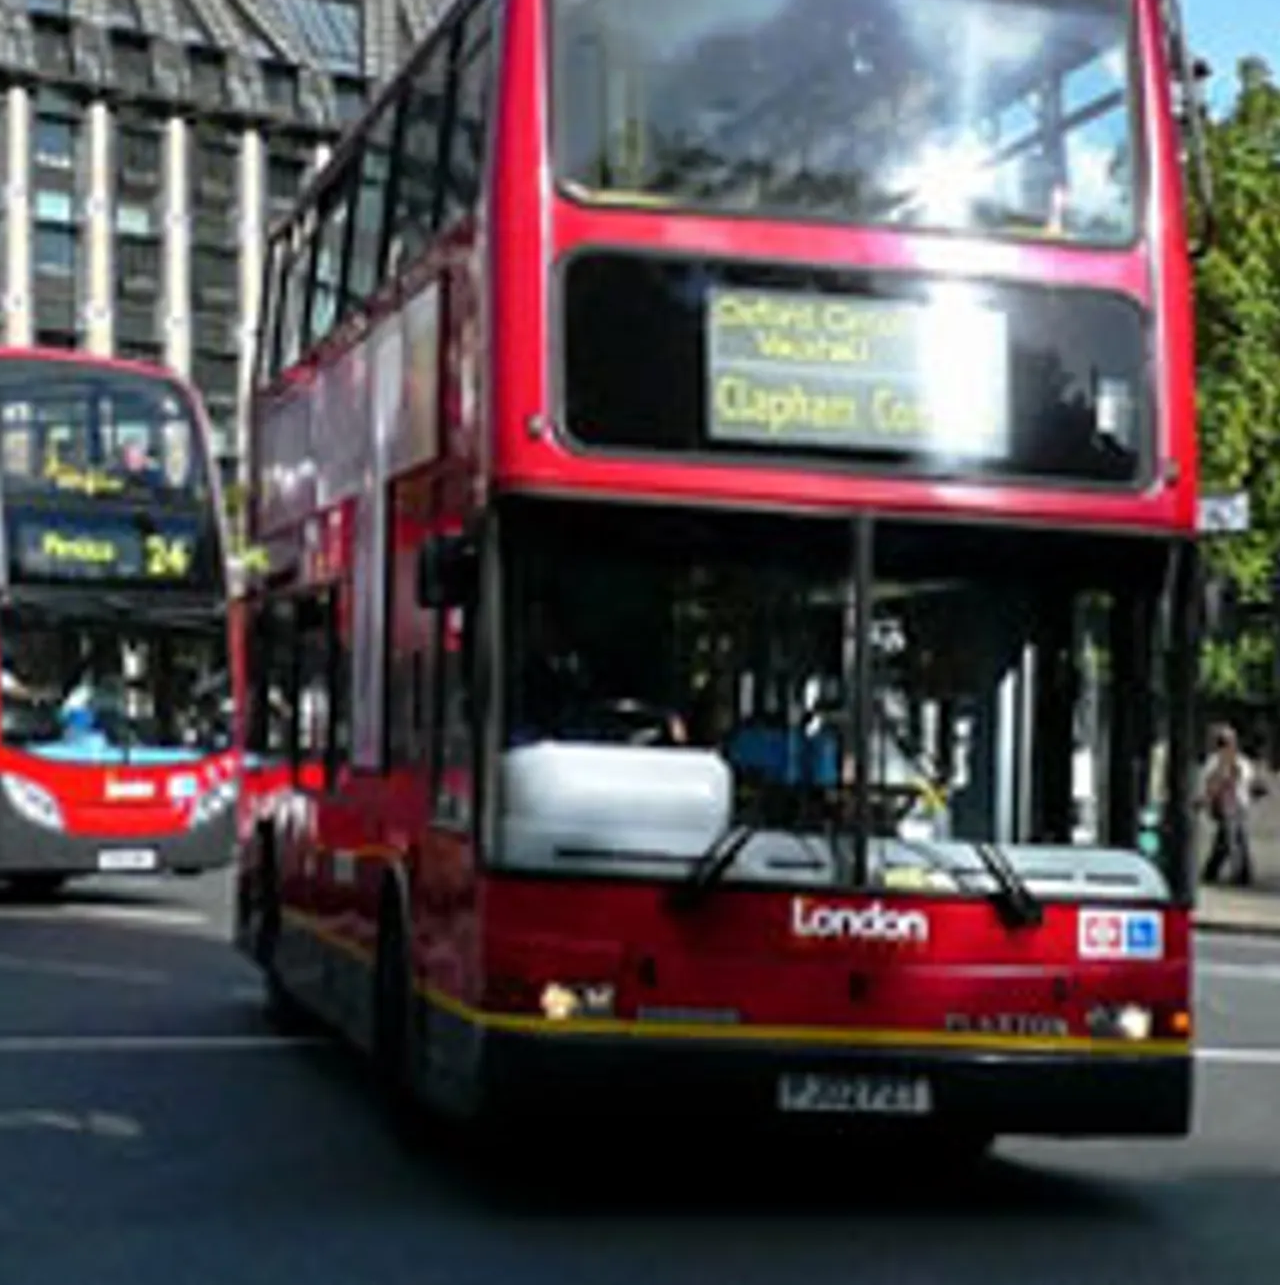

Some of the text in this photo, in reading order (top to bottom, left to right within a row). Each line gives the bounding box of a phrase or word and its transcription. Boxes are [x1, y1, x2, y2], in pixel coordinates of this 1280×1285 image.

[719, 375, 854, 432] Clapham
[146, 534, 191, 576] 24
[793, 896, 929, 942] London
